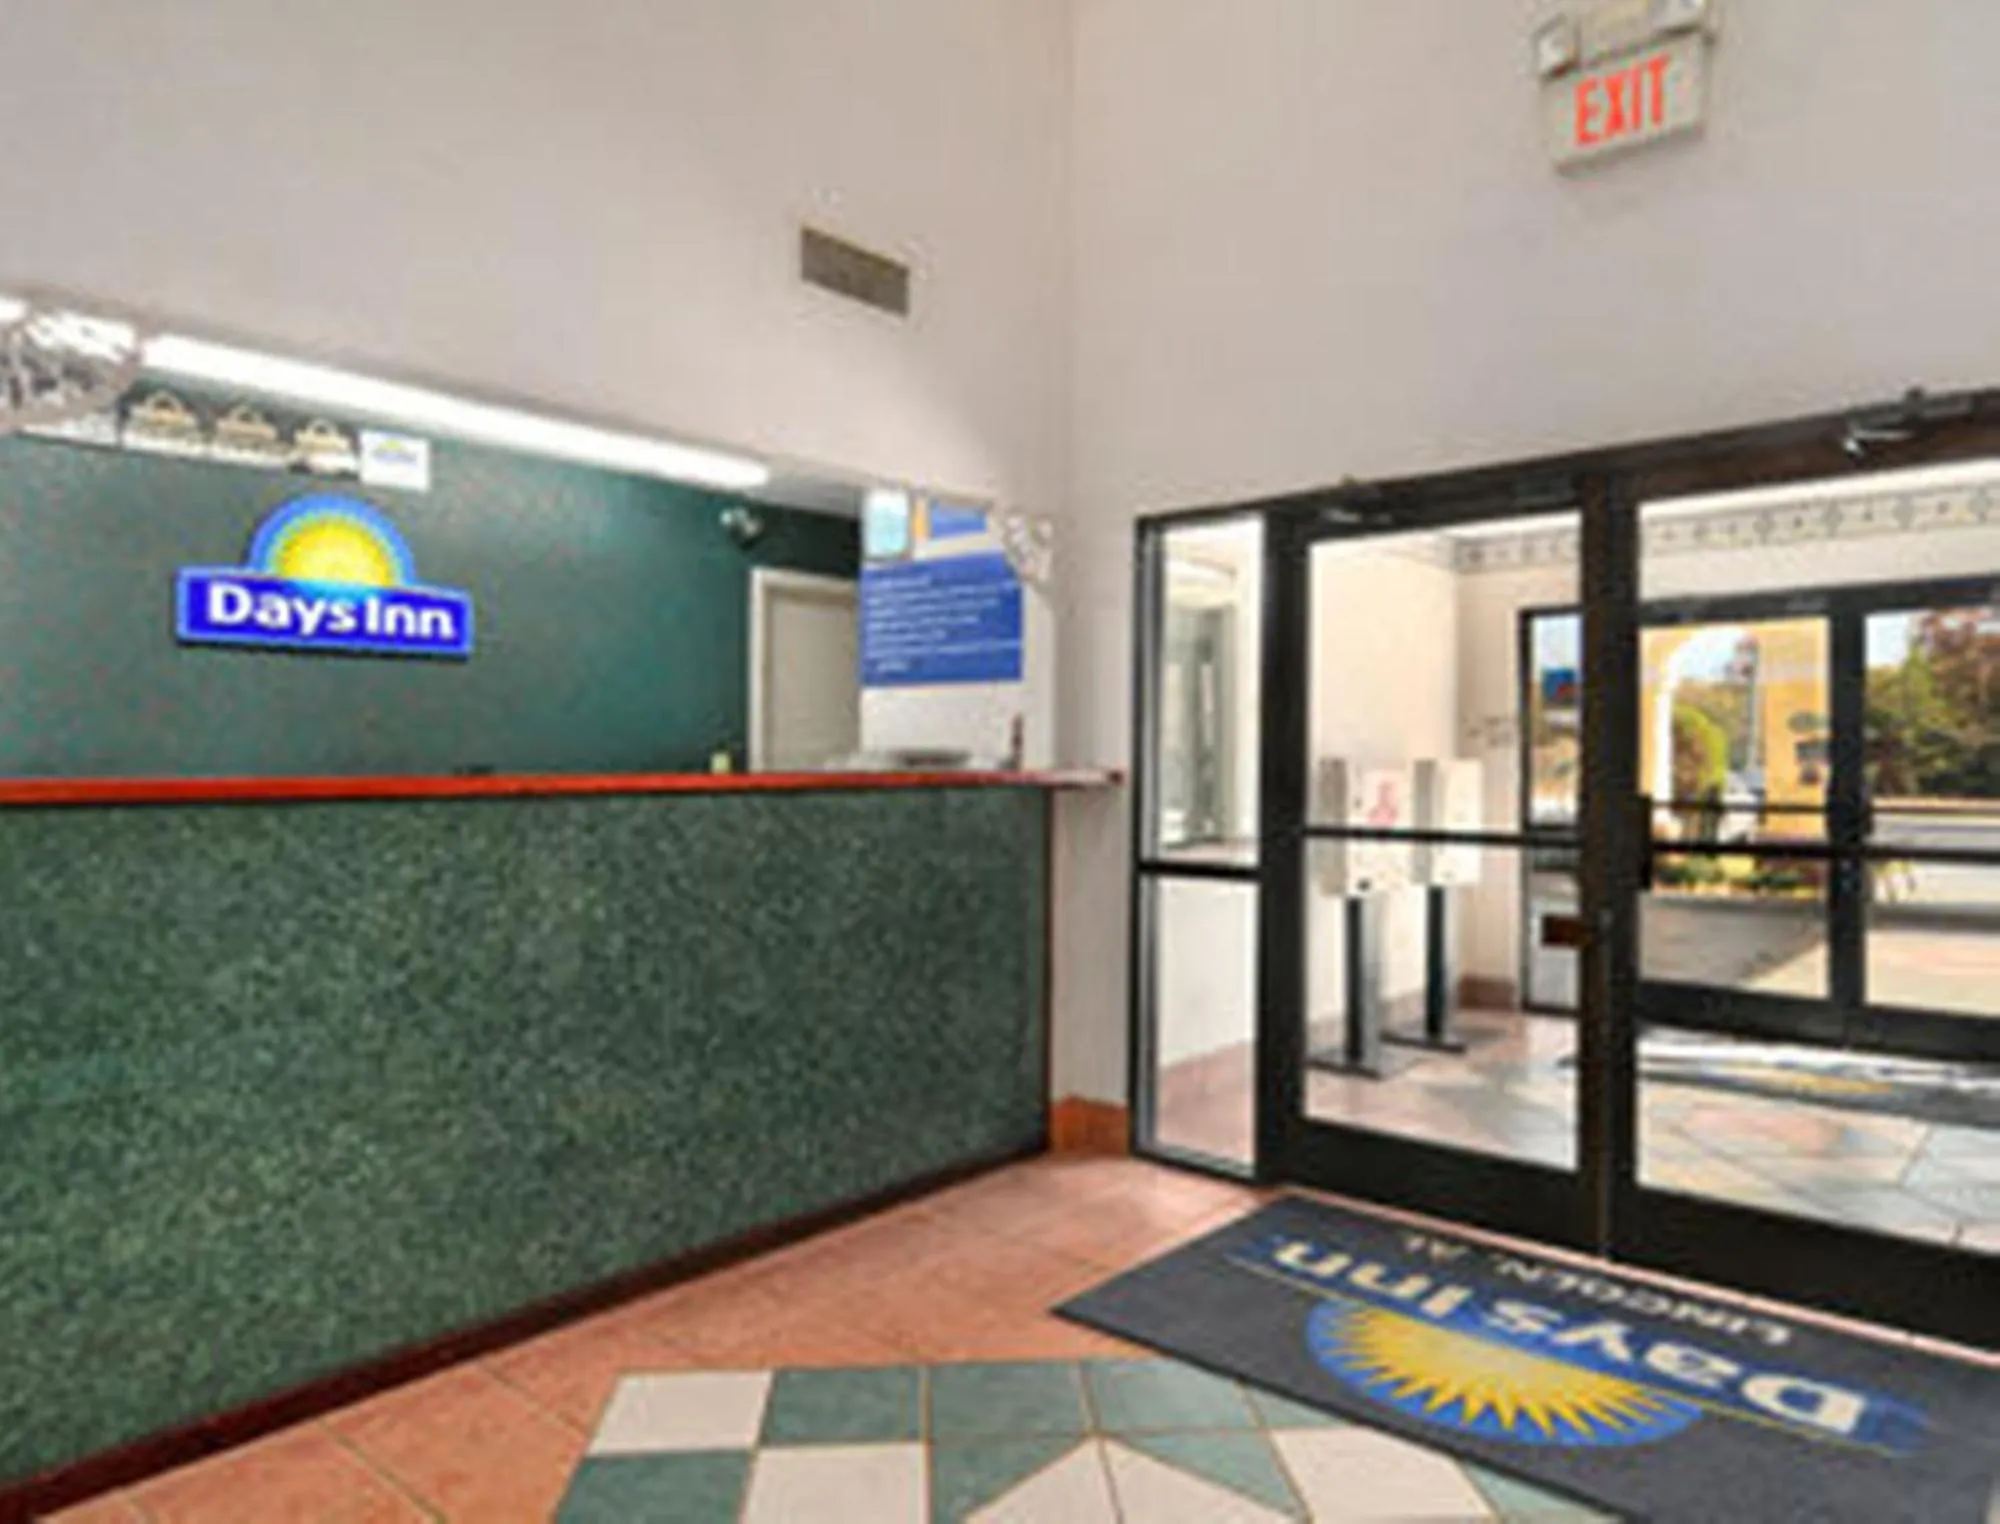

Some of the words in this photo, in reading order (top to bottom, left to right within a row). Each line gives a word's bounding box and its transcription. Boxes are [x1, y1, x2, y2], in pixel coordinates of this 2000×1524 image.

[1573, 52, 1669, 146] EXIT
[207, 580, 357, 636] Days
[365, 596, 456, 639] Inn
[1273, 1240, 1475, 1319] Inn
[1486, 1300, 1867, 1433] Days
